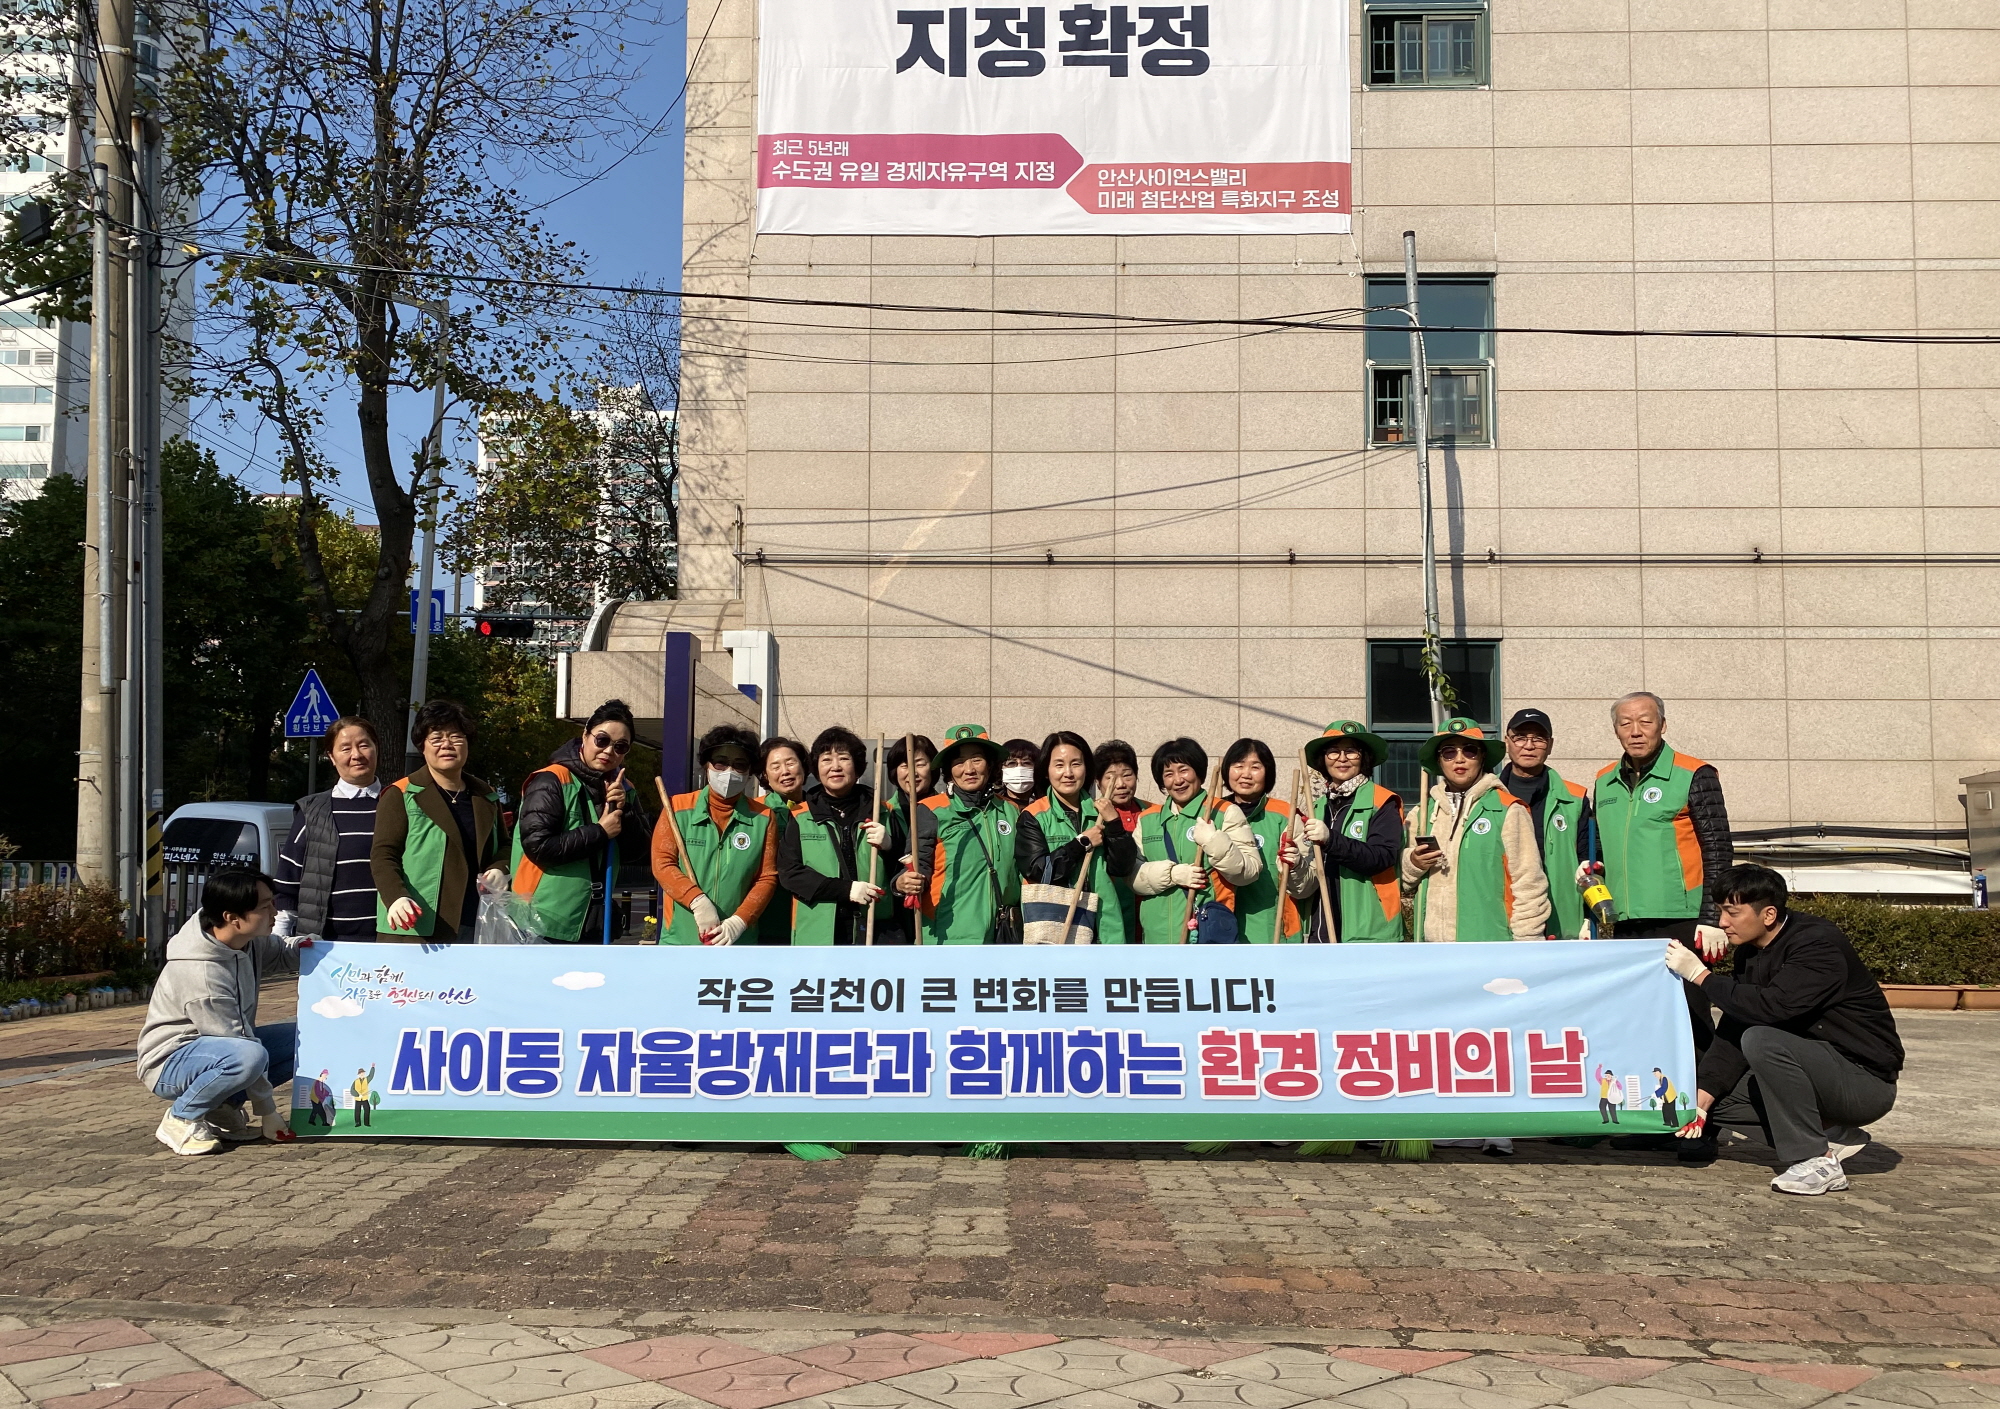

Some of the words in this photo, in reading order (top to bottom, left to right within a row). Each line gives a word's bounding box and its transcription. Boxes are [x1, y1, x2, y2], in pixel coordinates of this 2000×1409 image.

[772, 140, 804, 157] 최근
[808, 141, 850, 158] 5년래
[772, 161, 833, 183] 수도권
[839, 162, 881, 183] 유일
[887, 162, 1009, 184] 경제자유구역
[1015, 162, 1056, 183] 지정
[1097, 168, 1248, 188] 안산사이언스밸리
[1097, 191, 1136, 210] 미래
[1141, 191, 1217, 210] 첨단산업
[1221, 191, 1298, 210] 특화지구
[1302, 190, 1341, 210] 조성
[330, 962, 373, 988] 시민과
[341, 987, 384, 1010] 자유로운
[387, 986, 435, 1008] 혁신도시
[438, 987, 478, 1006] 안산
[698, 978, 775, 1014] 작은
[790, 978, 906, 1014] 실천이
[921, 979, 959, 1014] 큰
[974, 978, 1090, 1014] 변화를
[1105, 978, 1278, 1015] 만듭니다!
[392, 1031, 561, 1096] 사이동
[580, 1031, 932, 1097] 자율방재단과
[950, 1031, 1183, 1097] 함께하는
[1202, 1031, 1320, 1098] 환경
[1337, 1032, 1512, 1098] 정비의
[1529, 1031, 1586, 1096] 날
